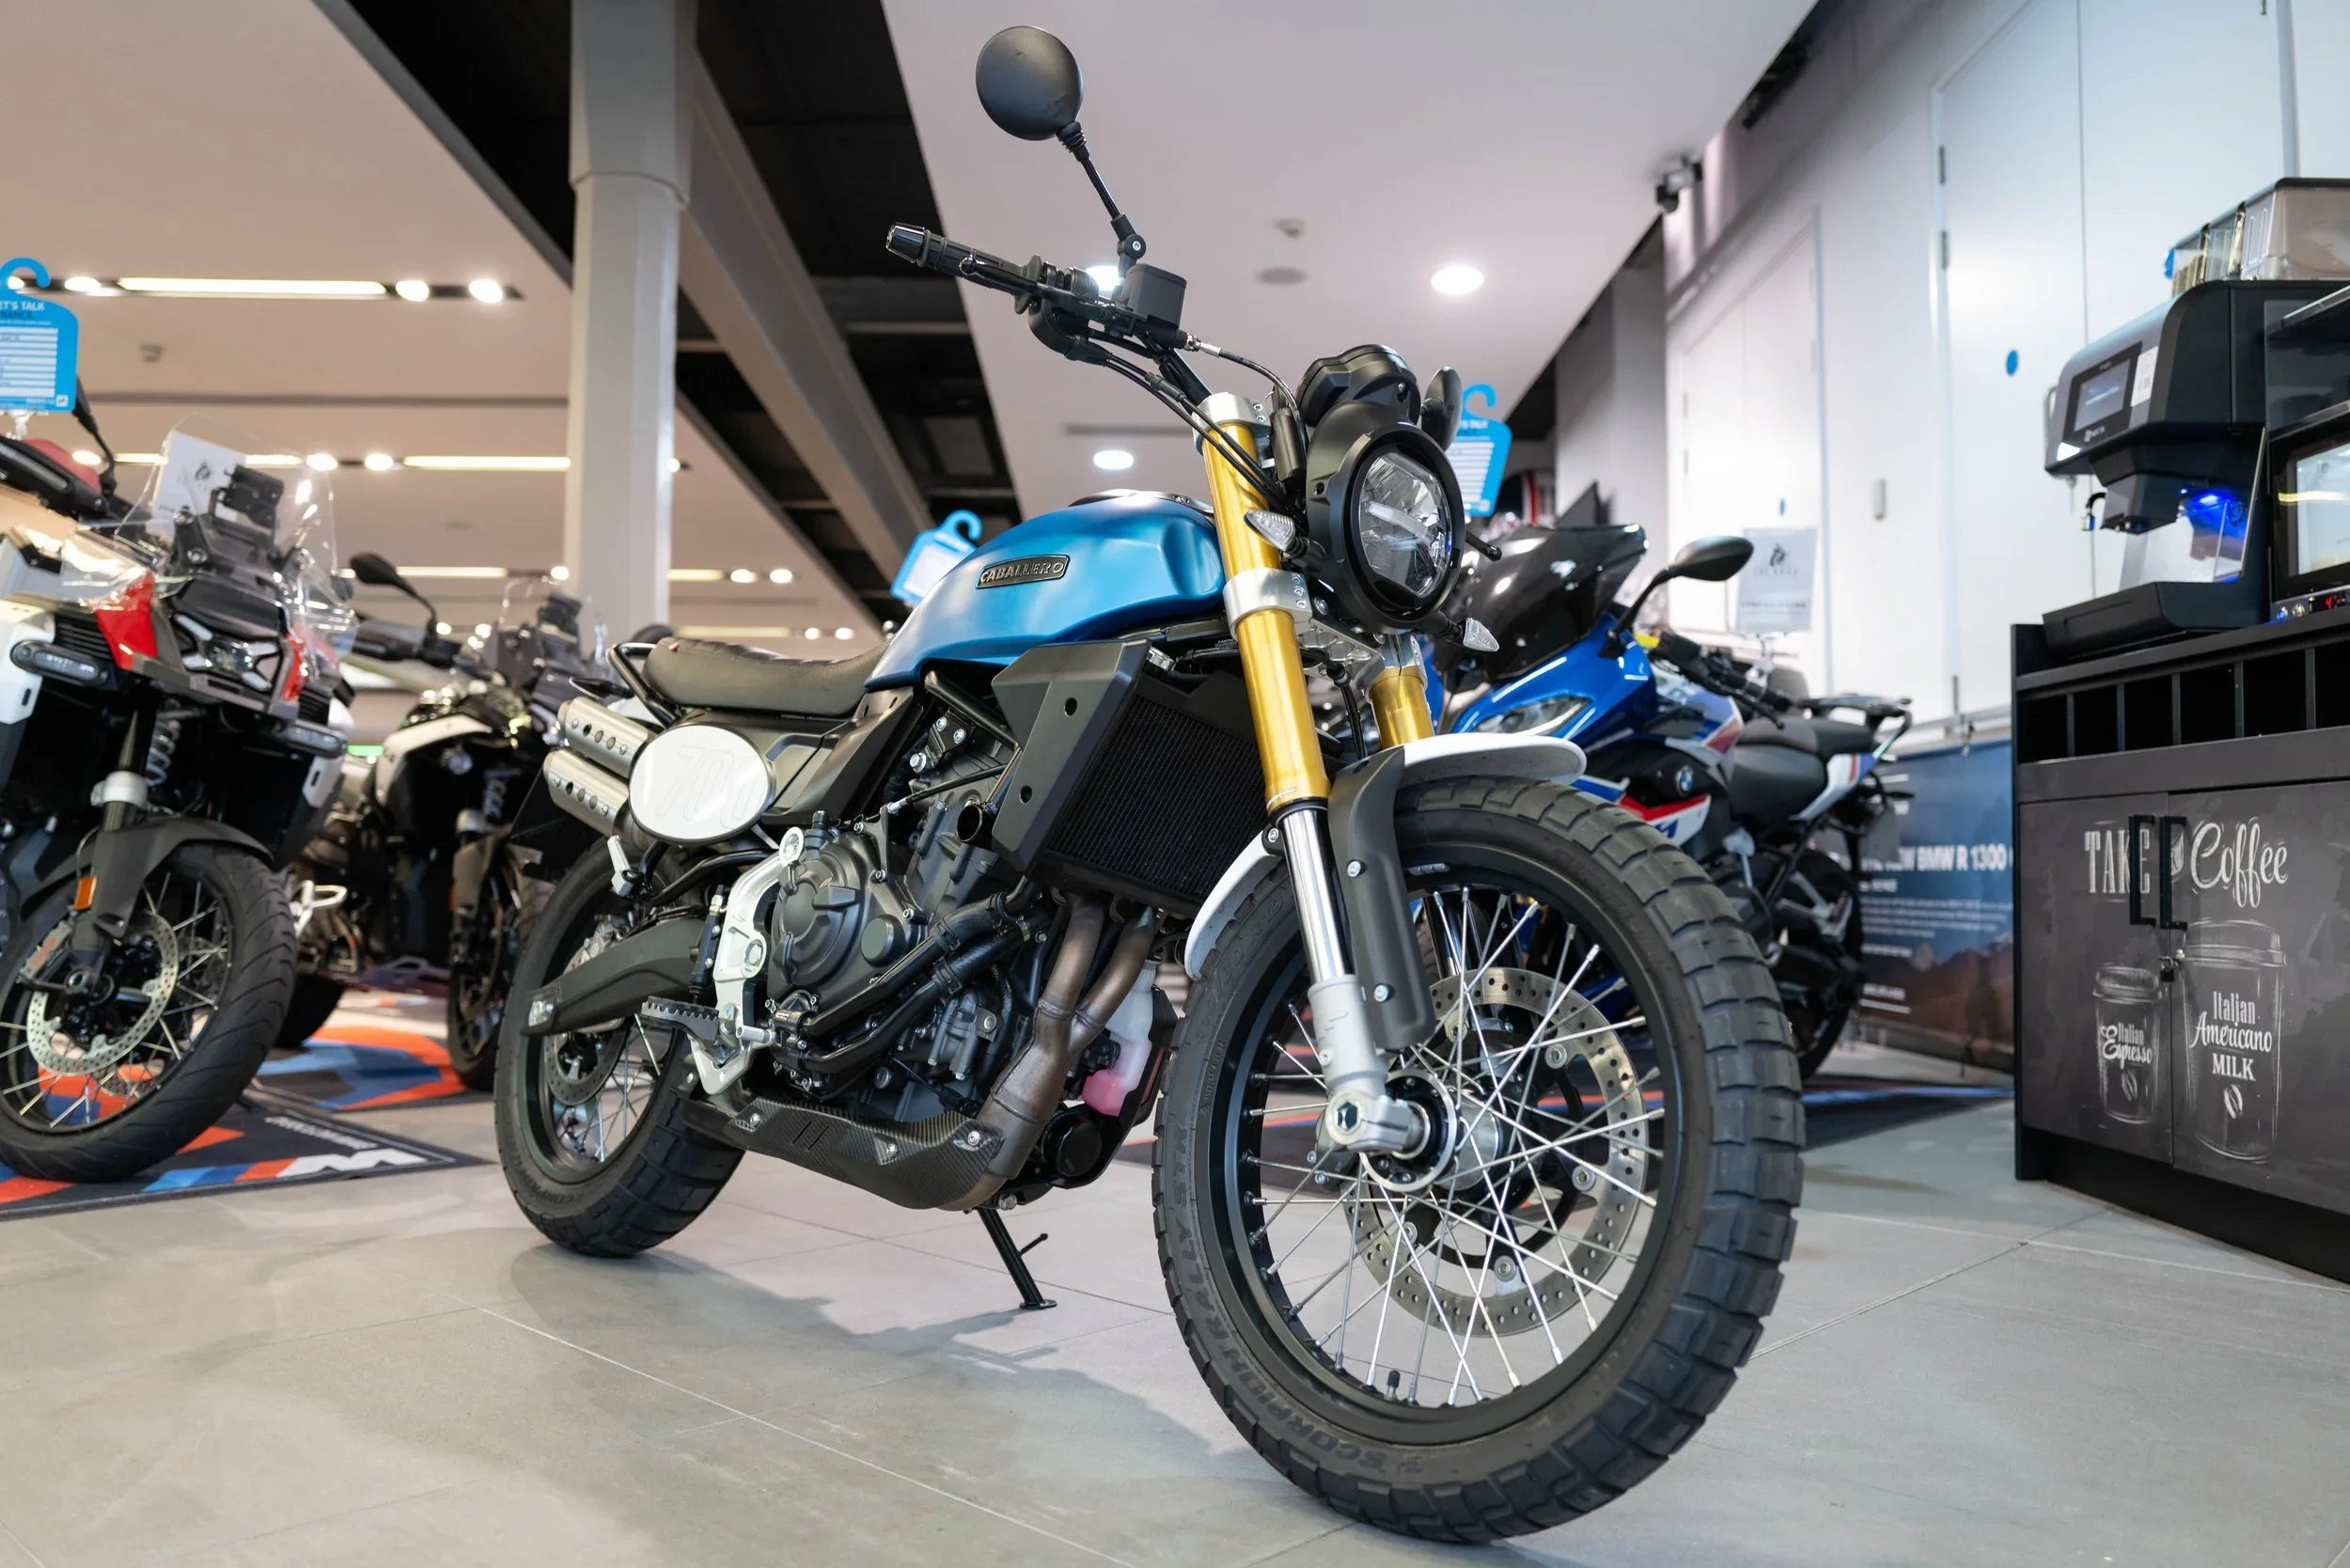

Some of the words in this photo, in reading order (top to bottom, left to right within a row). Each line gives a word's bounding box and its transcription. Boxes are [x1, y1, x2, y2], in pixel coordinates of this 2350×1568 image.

[980, 562, 1064, 583] CABALLERO
[1971, 843, 2008, 871] 1300
[2084, 828, 2151, 894] TAKE
[2191, 822, 2288, 909] Coffee
[2213, 991, 2256, 1025] Italian
[2100, 1024, 2153, 1070] Espresso
[2117, 1022, 2145, 1046] Italian
[2189, 1011, 2273, 1053] Americano
[2212, 1052, 2257, 1082] MILK
